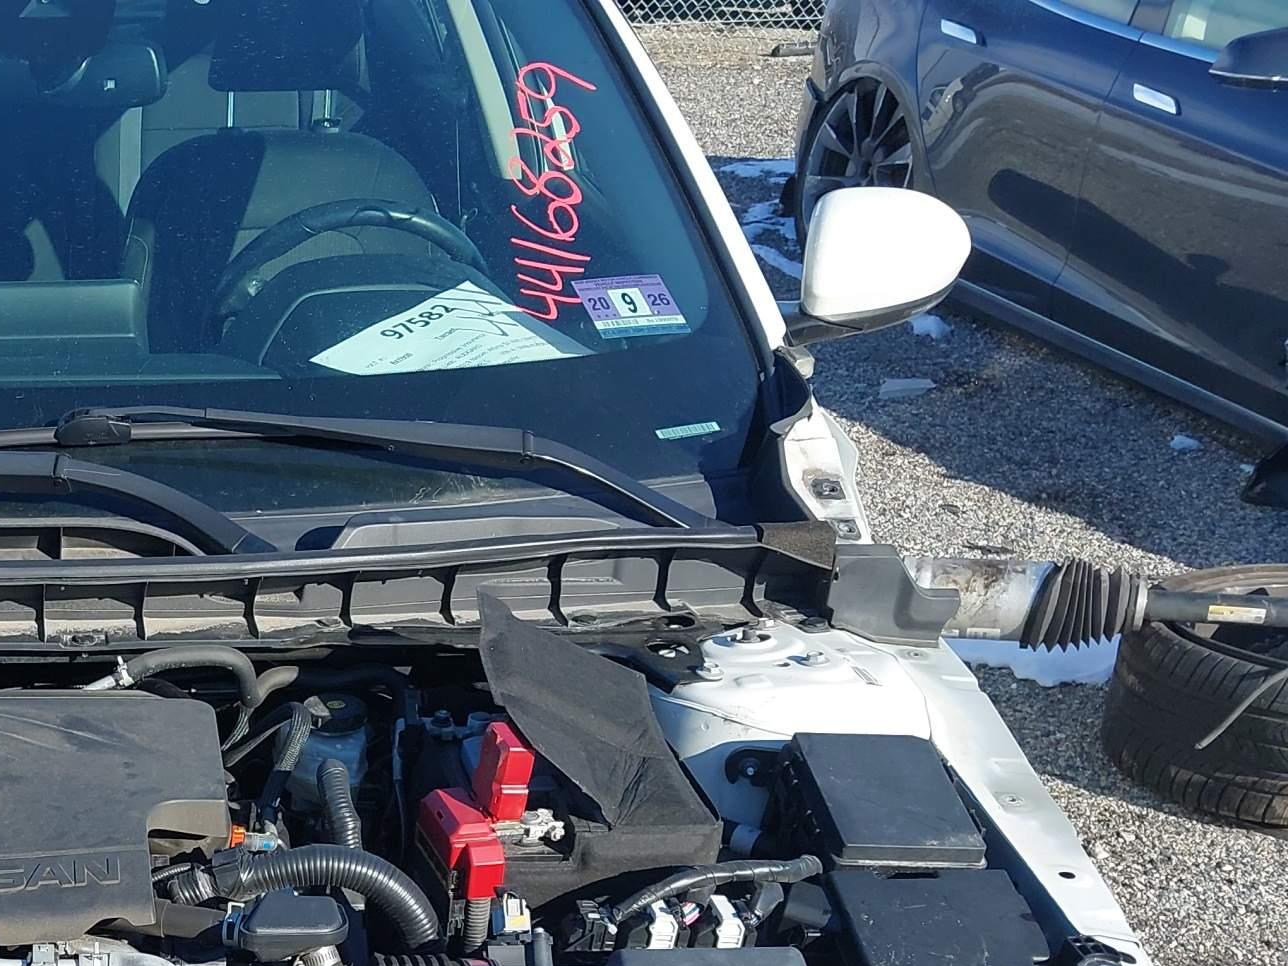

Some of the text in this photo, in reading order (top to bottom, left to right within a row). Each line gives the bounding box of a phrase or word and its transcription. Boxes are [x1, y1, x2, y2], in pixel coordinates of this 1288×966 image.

[508, 62, 598, 320] 44168259
[588, 292, 671, 313] 20 9 26
[380, 304, 453, 340] 97582
